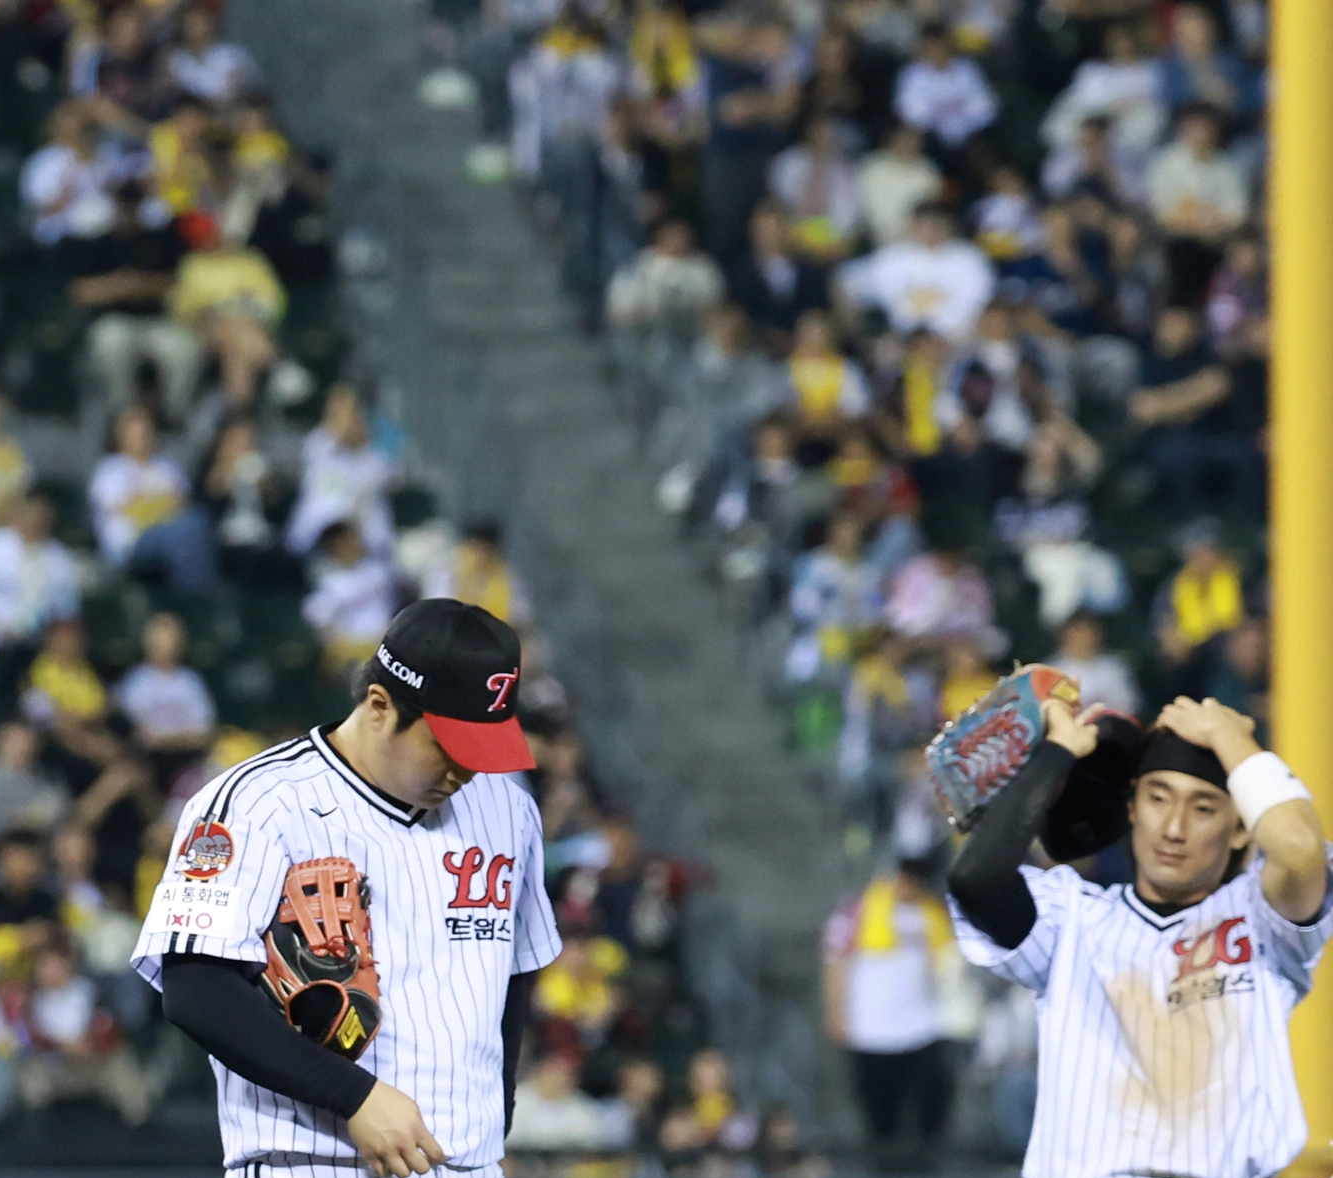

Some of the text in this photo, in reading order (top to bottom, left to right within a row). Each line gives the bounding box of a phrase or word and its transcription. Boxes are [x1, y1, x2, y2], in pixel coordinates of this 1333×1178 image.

[181, 886, 231, 907] 통화앱
[442, 845, 516, 912] LG
[1171, 915, 1253, 984] LG
